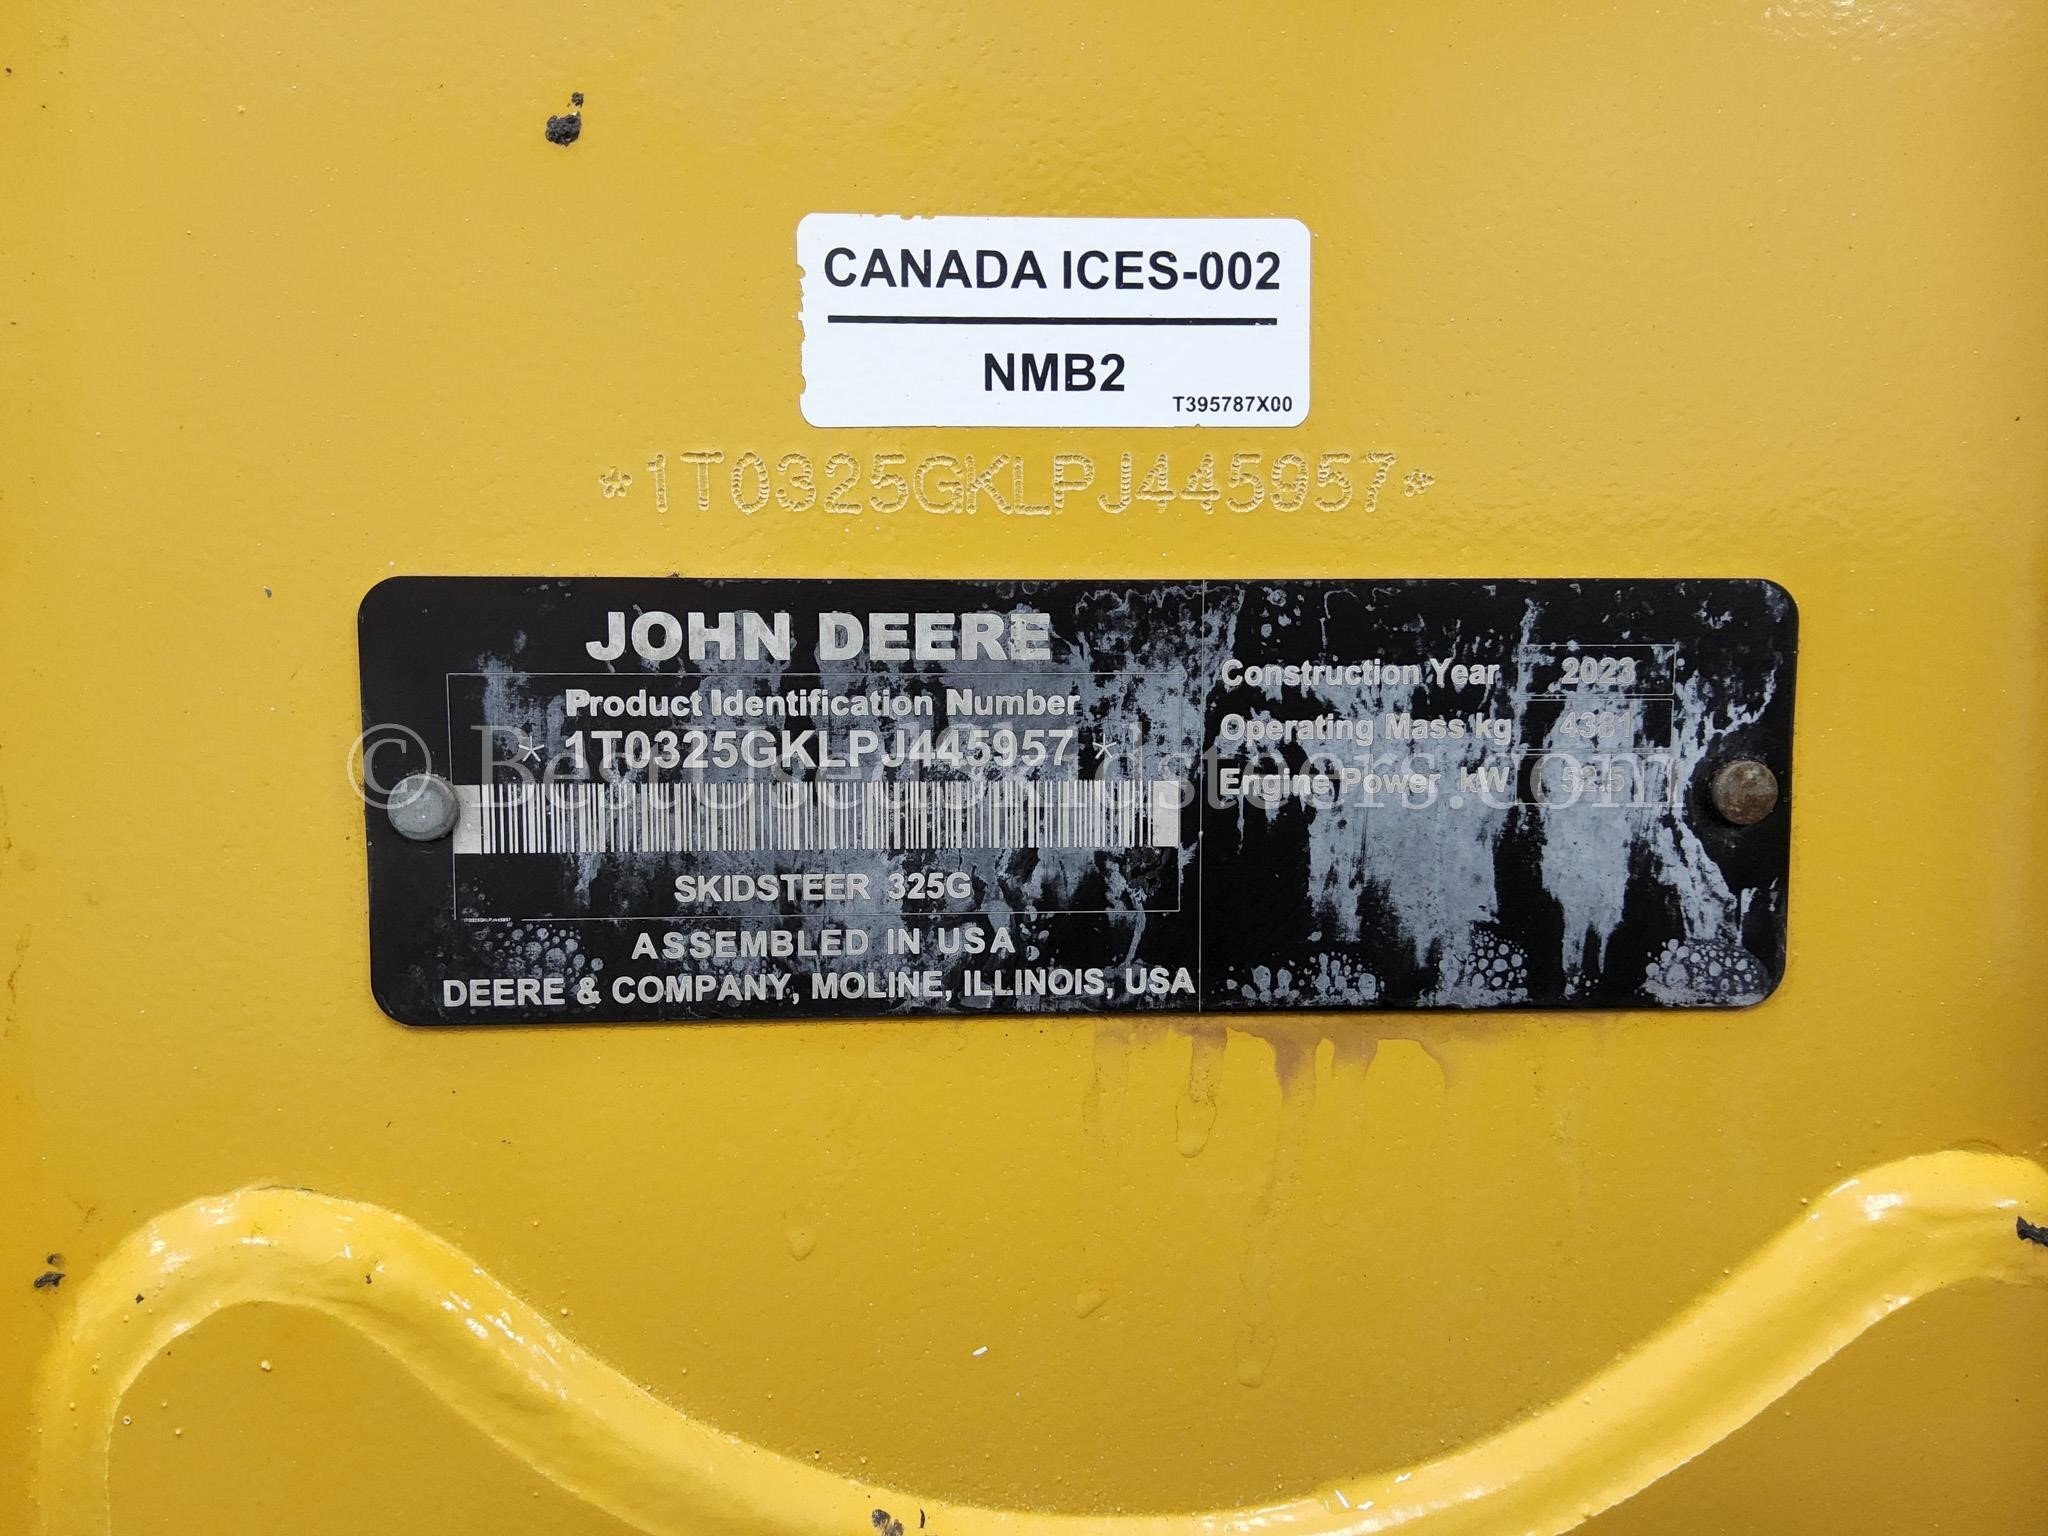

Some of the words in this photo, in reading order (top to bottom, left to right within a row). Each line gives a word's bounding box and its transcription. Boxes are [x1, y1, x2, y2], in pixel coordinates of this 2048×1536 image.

[824, 247, 1047, 290] CANADA
[1064, 250, 1280, 290] ICES-002
[984, 353, 1126, 392] NMB2
[1173, 396, 1293, 413] T395787X00
[585, 611, 791, 661] JOHN
[818, 612, 1051, 661] DEERE
[1221, 658, 1420, 687] Construction
[1429, 658, 1500, 686] Year
[1561, 656, 1636, 684] 2023
[565, 689, 702, 717] Product
[711, 689, 933, 717] Identification
[946, 689, 1080, 716] Number
[1220, 713, 1374, 746] Operating
[1384, 713, 1464, 740] Mass
[1476, 713, 1512, 746] kg
[1559, 711, 1632, 738] 4381
[565, 730, 1074, 770] 1T0325GKLPJ445957
[1220, 767, 1329, 800] Engine
[1341, 767, 1441, 793] Power
[1459, 767, 1511, 793] kW
[674, 873, 870, 902] SKIDSTEER
[888, 872, 971, 900] 325G
[631, 929, 869, 960] ASSEMBLED
[888, 929, 920, 955] IN
[938, 927, 1015, 954] USA
[443, 977, 566, 1007] DEERE
[577, 977, 602, 1005] &
[612, 973, 800, 1005] COMPANY,
[812, 970, 952, 1001] MOLINE,
[964, 968, 1113, 999] ILLINOIS,
[1125, 967, 1196, 994] USA
